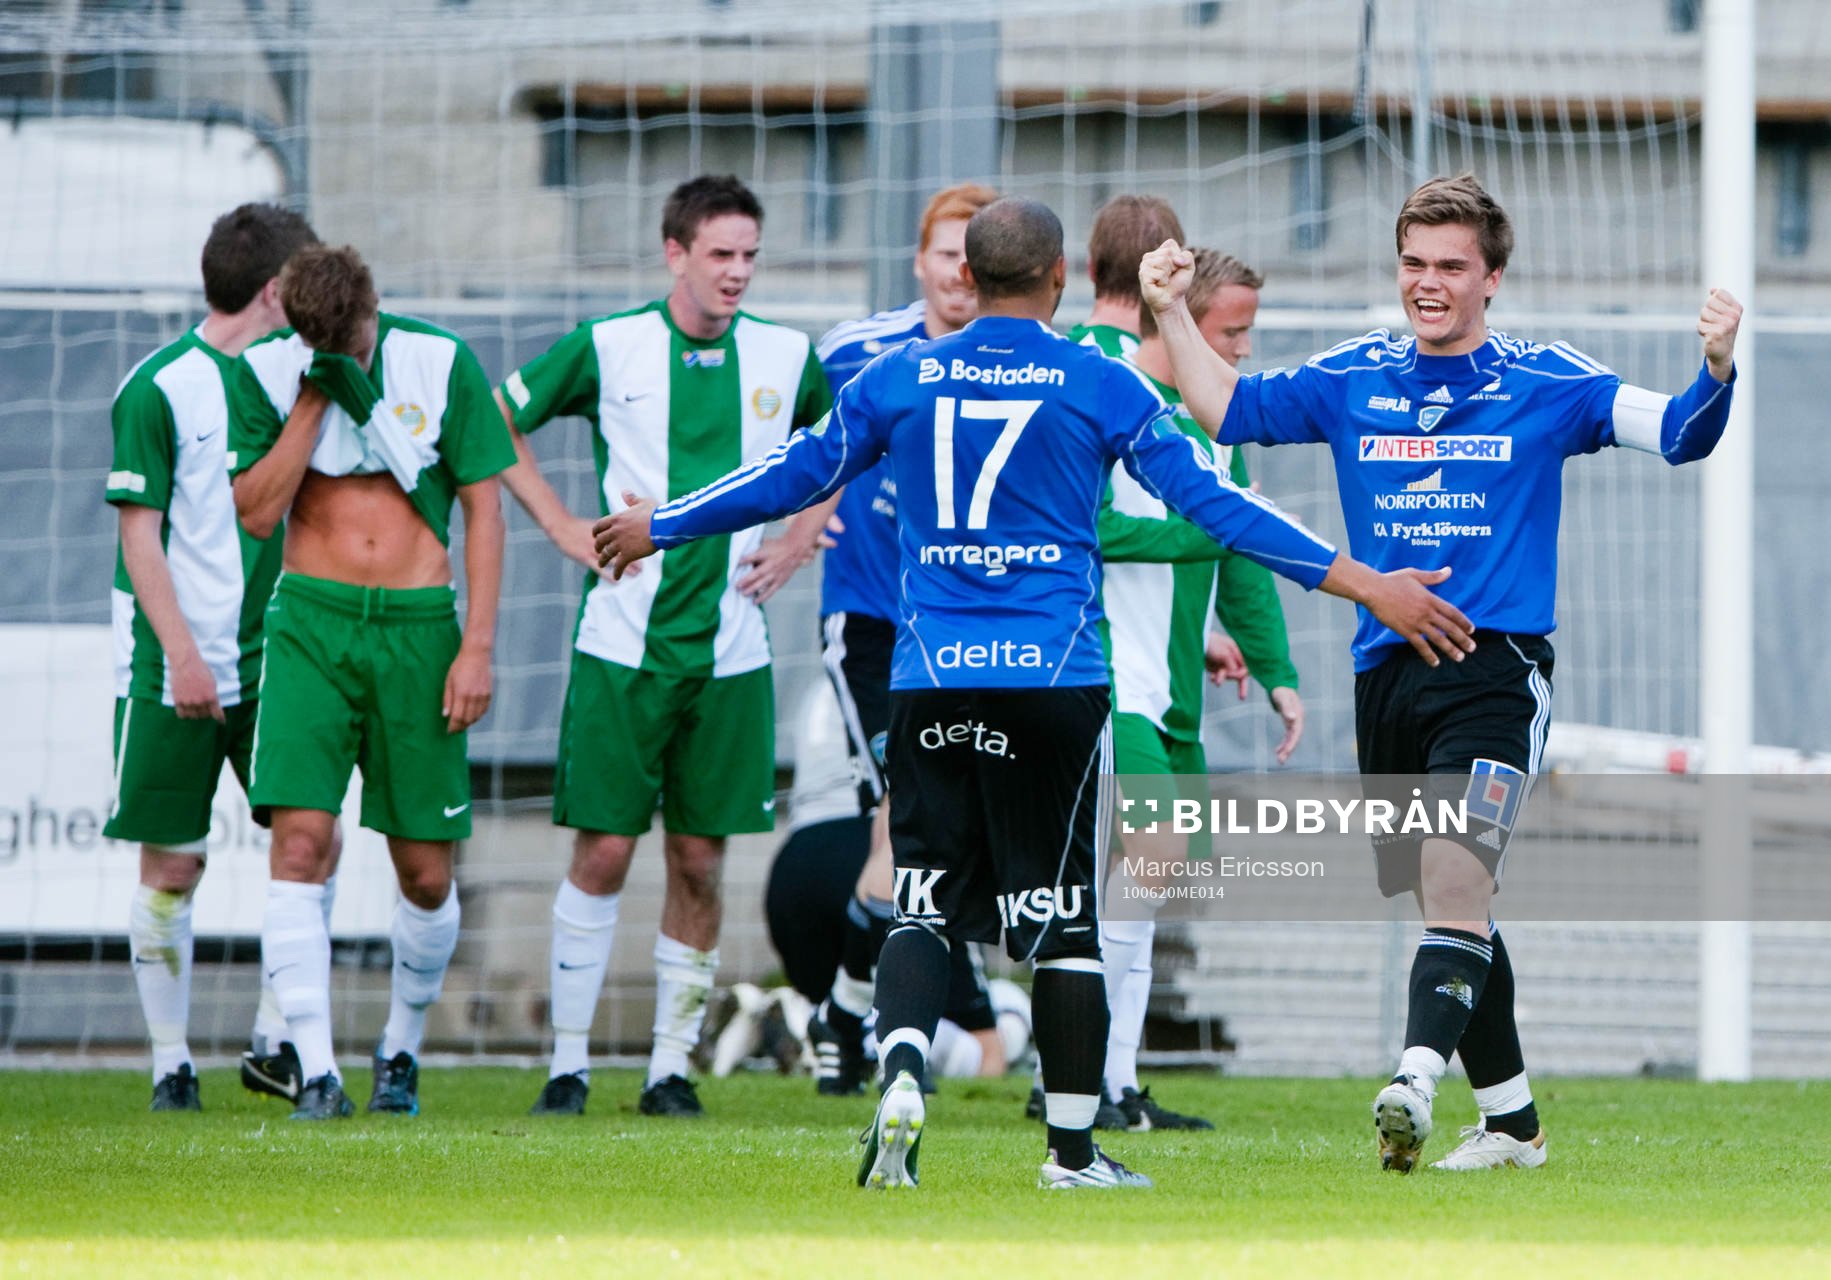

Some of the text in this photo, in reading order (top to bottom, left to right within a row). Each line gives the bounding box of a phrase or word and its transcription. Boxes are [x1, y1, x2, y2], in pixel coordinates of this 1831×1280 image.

[950, 358, 1065, 386] Bostaden
[1377, 439, 1504, 458] INTERSPORT
[934, 396, 1044, 530] 17
[1375, 492, 1485, 510] NORRPORTEN
[1391, 522, 1492, 540] Fyrklövern
[936, 640, 1053, 669] delta.
